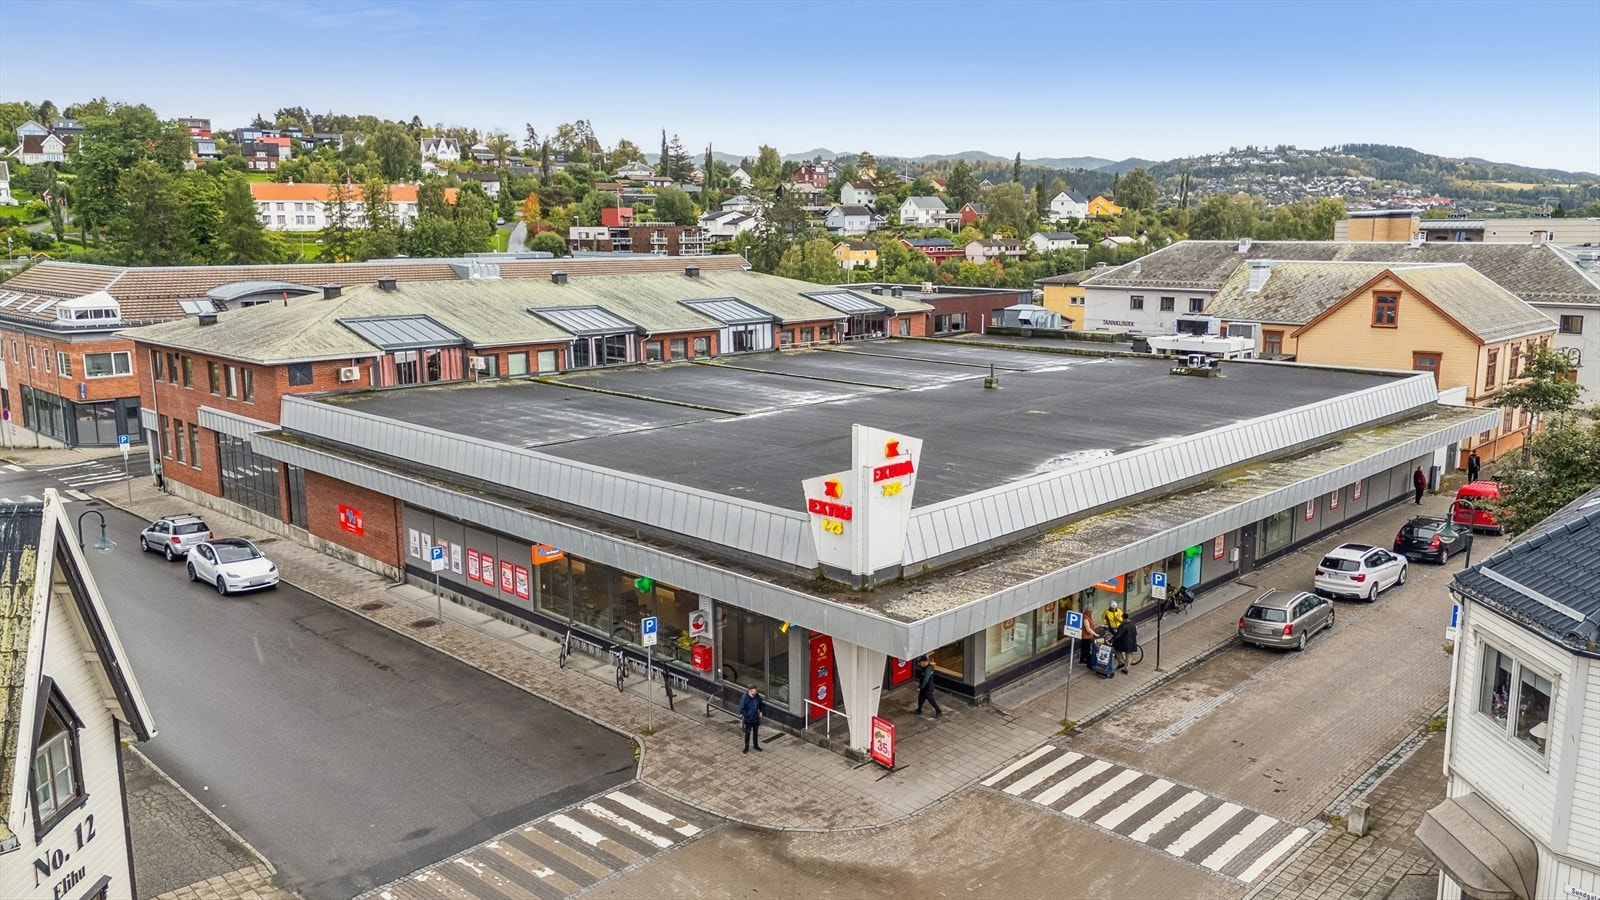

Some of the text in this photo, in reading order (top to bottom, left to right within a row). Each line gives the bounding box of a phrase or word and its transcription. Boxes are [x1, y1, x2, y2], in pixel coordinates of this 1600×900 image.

[1102, 319, 1135, 327] TANNKLINIKK
[433, 548, 441, 559] P
[1155, 574, 1163, 585] P
[1069, 613, 1078, 626] P
[646, 620, 654, 633] P
[33, 813, 96, 890] No. 12
[53, 866, 86, 900] Elihu
